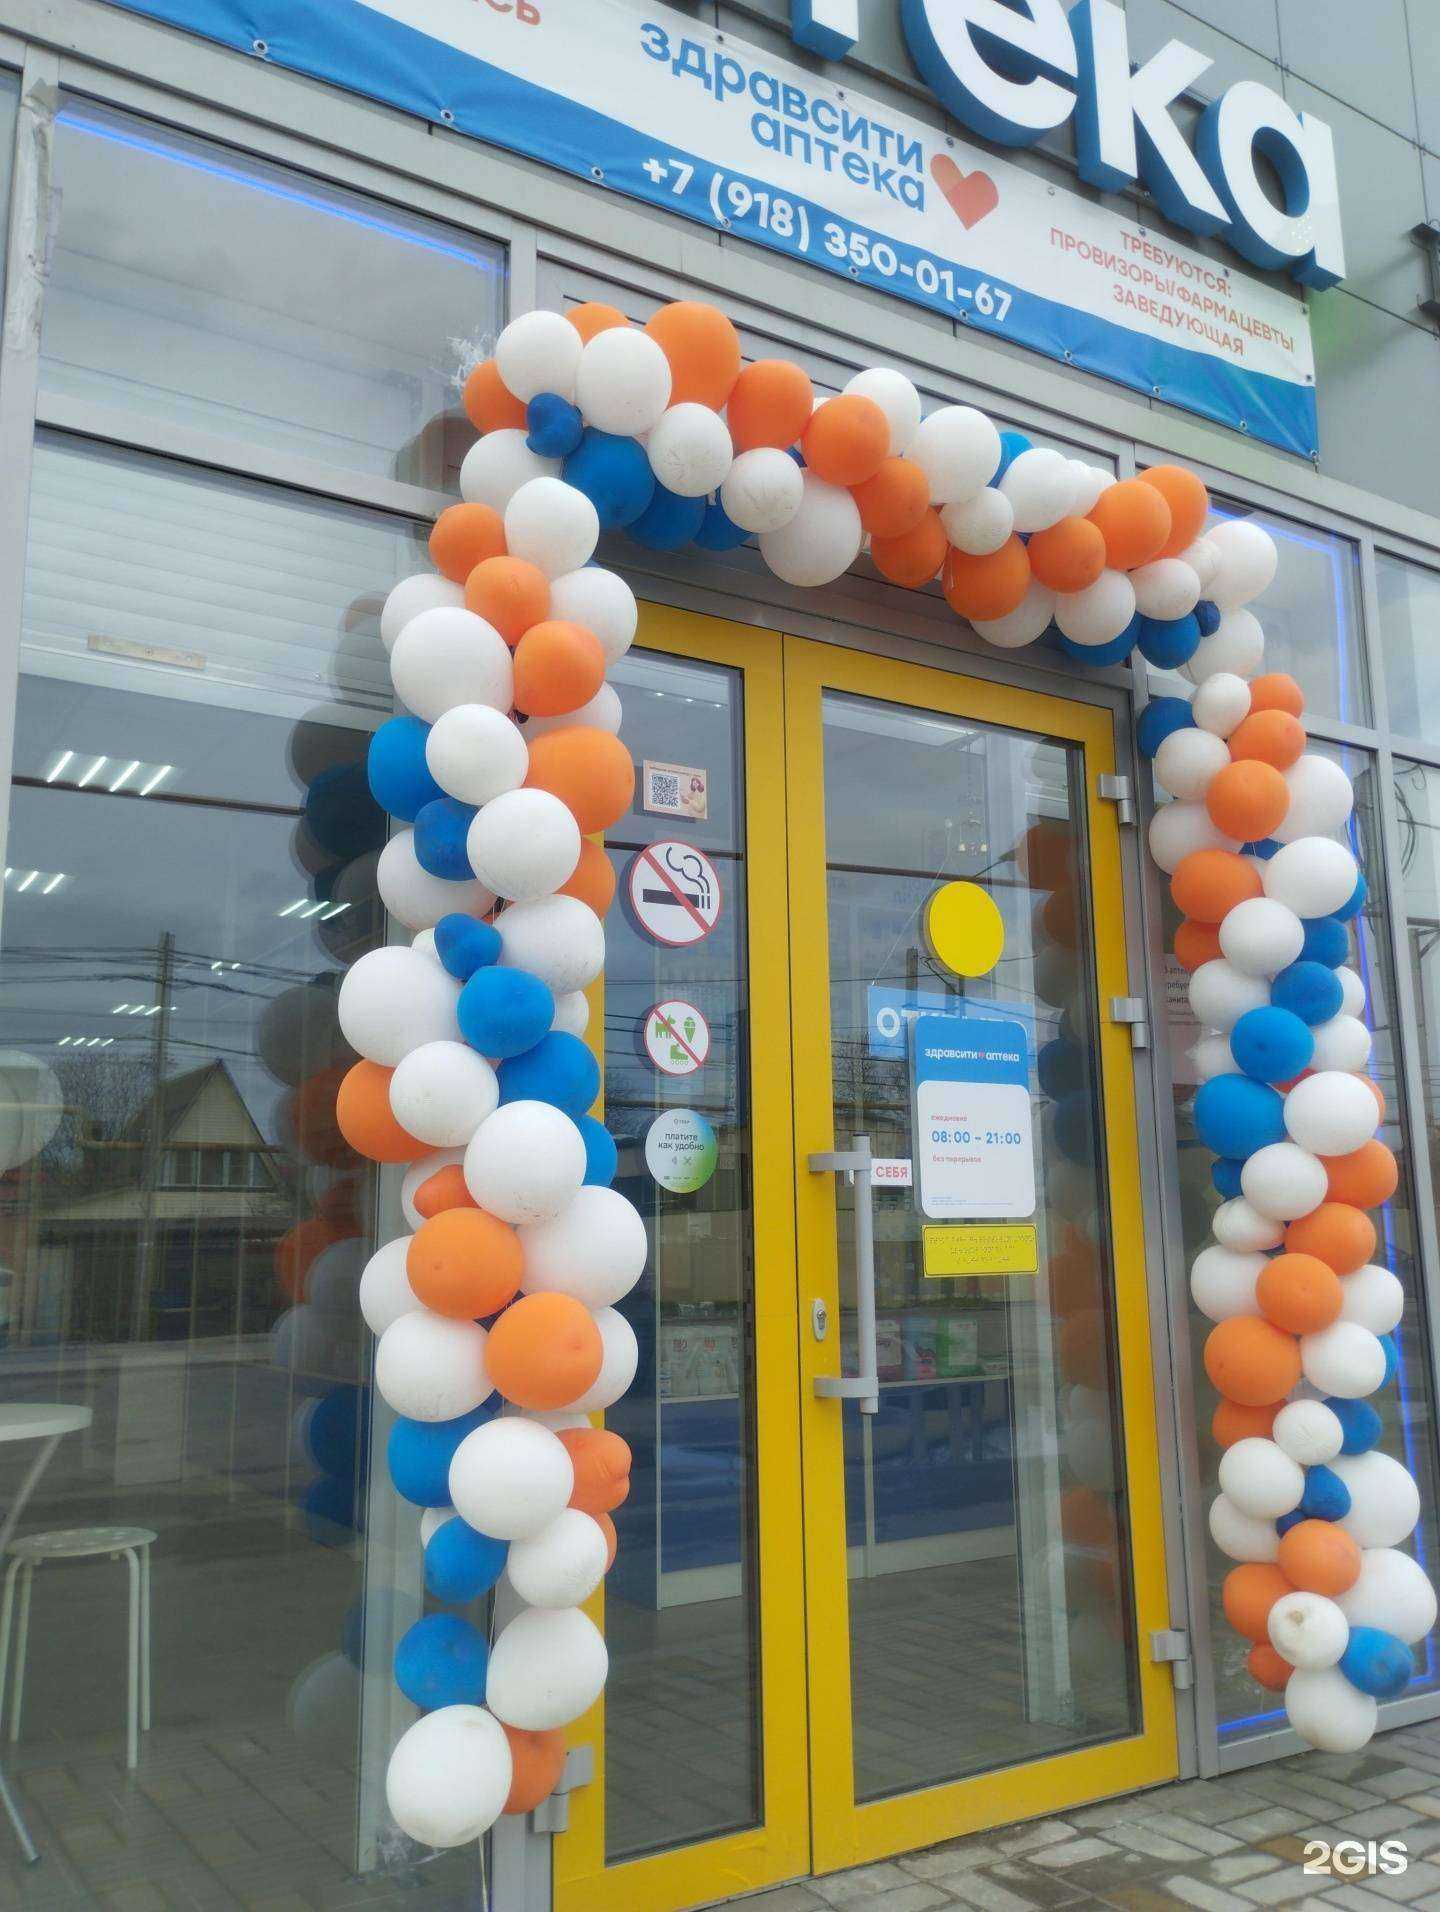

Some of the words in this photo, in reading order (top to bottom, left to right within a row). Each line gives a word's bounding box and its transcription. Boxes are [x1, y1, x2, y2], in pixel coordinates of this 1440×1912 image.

[640, 22, 924, 174] здравсити
[750, 112, 925, 213] аптека
[800, 0, 1346, 282] ека
[642, 158, 694, 195] +7
[709, 172, 810, 252] (918)
[823, 222, 1012, 322] 350-01-67
[1120, 230, 1232, 298] ТРЕБУЮТСЯ:
[1050, 227, 1293, 353] ПРОВИЗОРЫ/ФАРМАЦЕВТЫ
[1112, 284, 1244, 356] ЗАВЕДУЮЩАЯ
[924, 1048, 977, 1061] здравсити
[985, 1051, 1020, 1063] аптека
[664, 1133, 698, 1141] платите
[674, 1141, 705, 1152] удобно
[876, 1166, 908, 1178] СЕБЯ
[931, 1130, 971, 1144] 08:00
[985, 1132, 1021, 1145] 21:00
